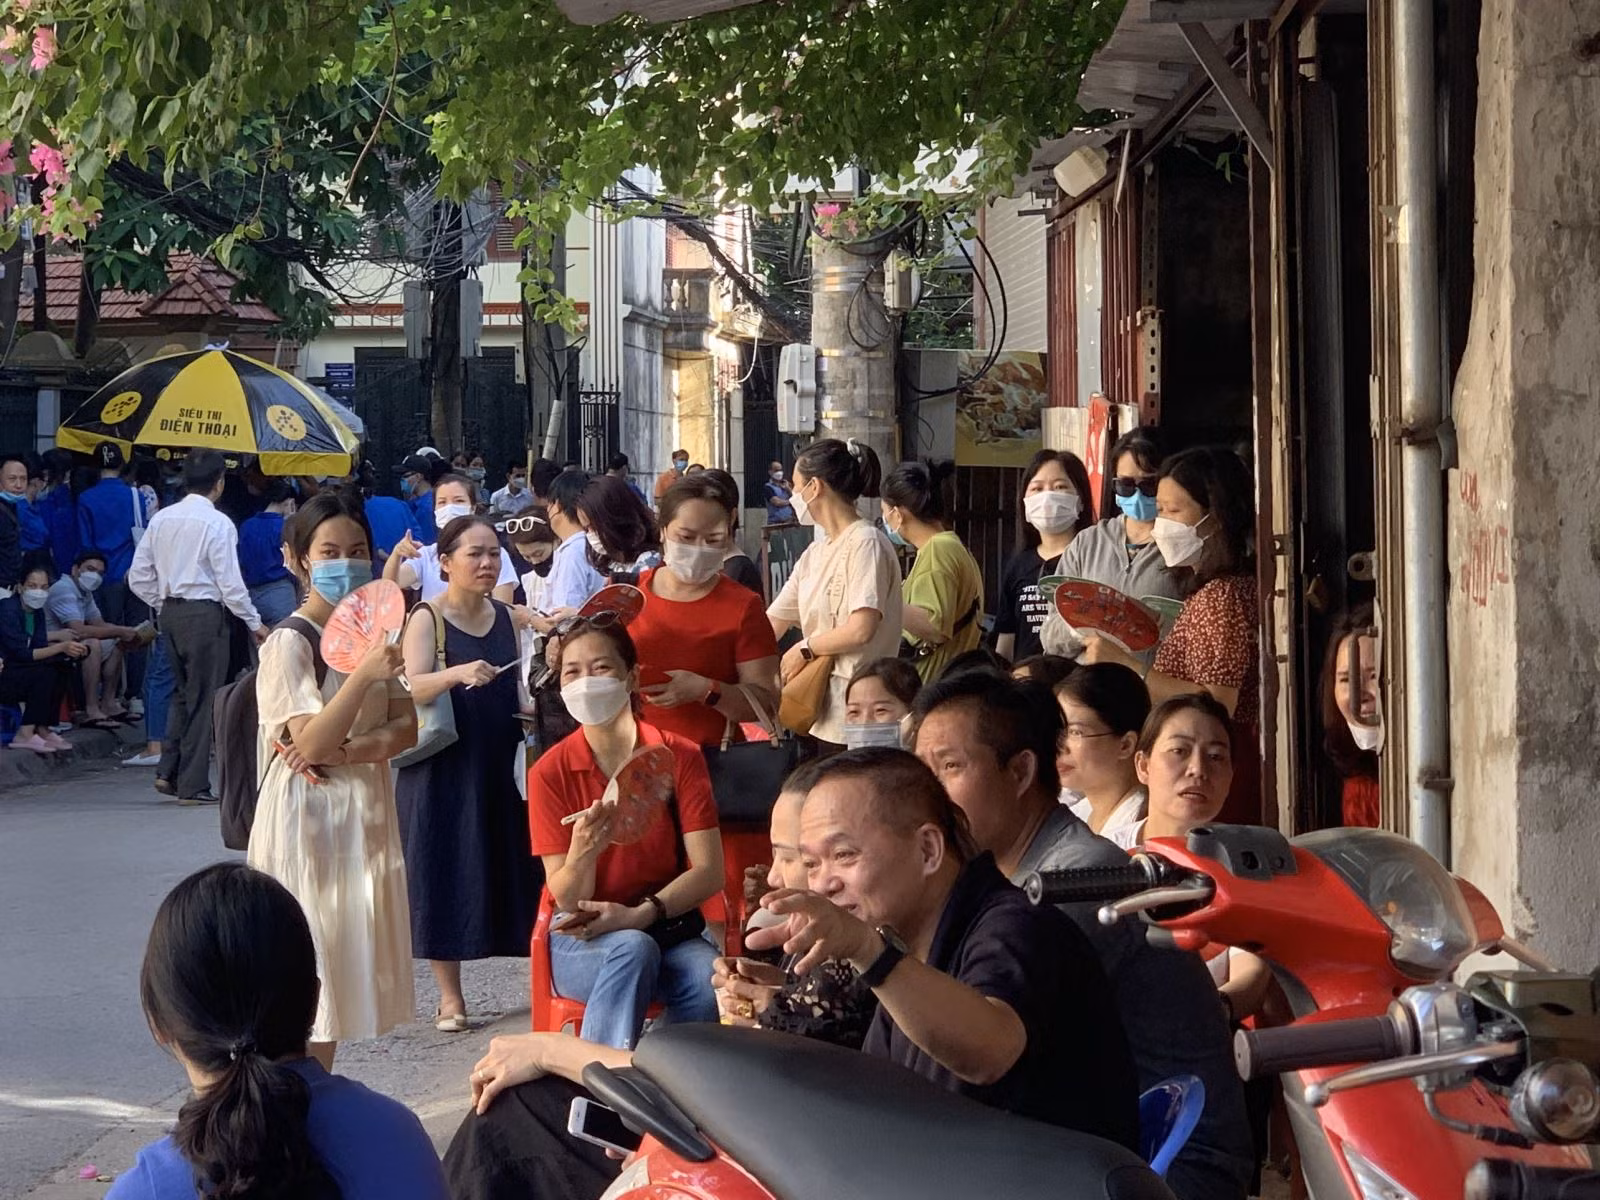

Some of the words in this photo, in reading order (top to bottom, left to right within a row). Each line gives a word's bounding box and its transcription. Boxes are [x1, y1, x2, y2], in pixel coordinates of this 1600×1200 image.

[179, 406, 203, 419] SIÊU
[207, 410, 222, 423] THỊ
[160, 418, 193, 435] ĐIỆN
[198, 421, 237, 439] THOẠI
[1021, 603, 1035, 612] ARE
